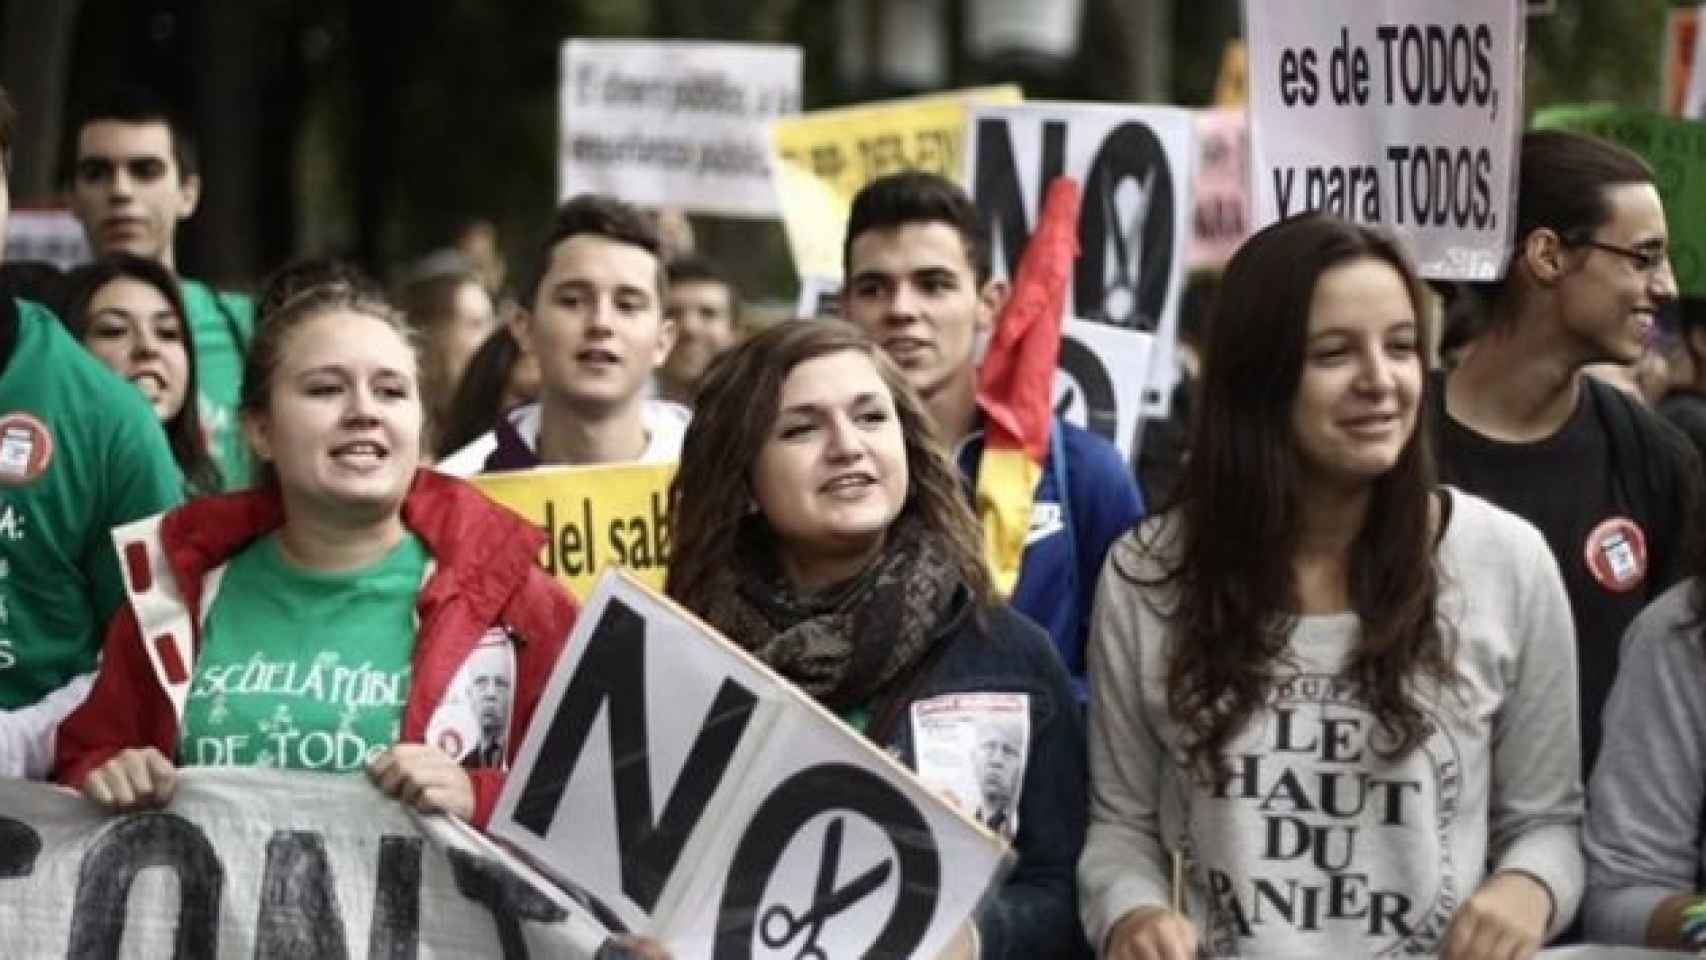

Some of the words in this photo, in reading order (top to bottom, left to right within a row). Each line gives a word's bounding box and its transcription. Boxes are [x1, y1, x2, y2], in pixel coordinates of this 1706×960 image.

[1280, 45, 1319, 107] es
[1330, 27, 1370, 107] de
[1376, 25, 1499, 120] TODOS,
[1386, 146, 1496, 230] TODOS.
[535, 497, 595, 577] del
[1272, 708, 1361, 763] LE
[511, 596, 942, 960] NO
[1213, 754, 1422, 826] HAUT
[1260, 816, 1360, 872] DU
[1207, 869, 1438, 937] PANIER
